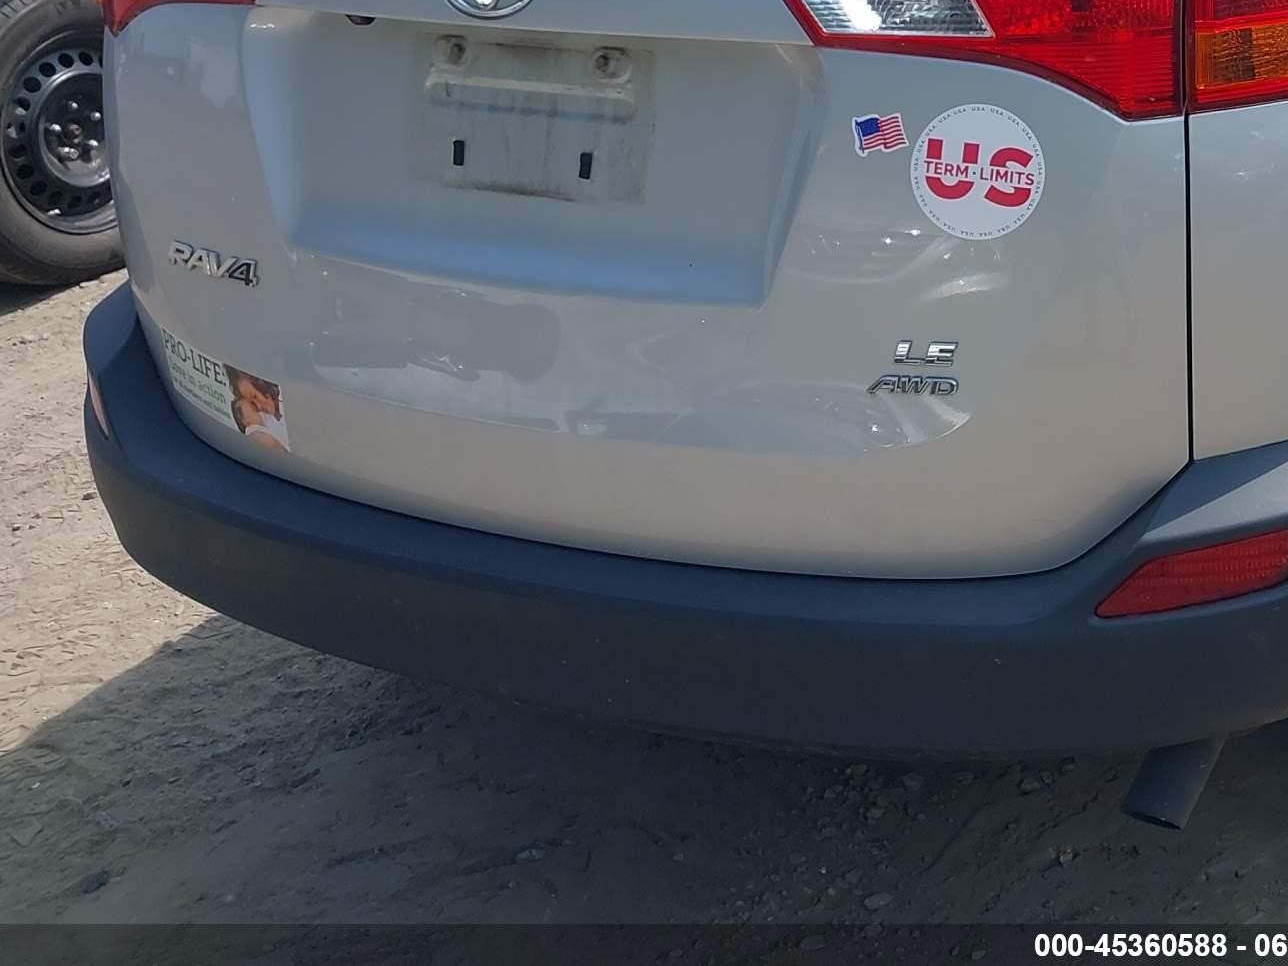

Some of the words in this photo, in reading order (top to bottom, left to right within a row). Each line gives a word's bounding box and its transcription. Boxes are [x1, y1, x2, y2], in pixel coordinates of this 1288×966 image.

[923, 160, 969, 179] TERM
[979, 167, 1035, 186] LIMITS
[925, 138, 1034, 208] US
[168, 240, 259, 288] RAV4
[894, 339, 959, 367] LE
[866, 374, 959, 396] AWD
